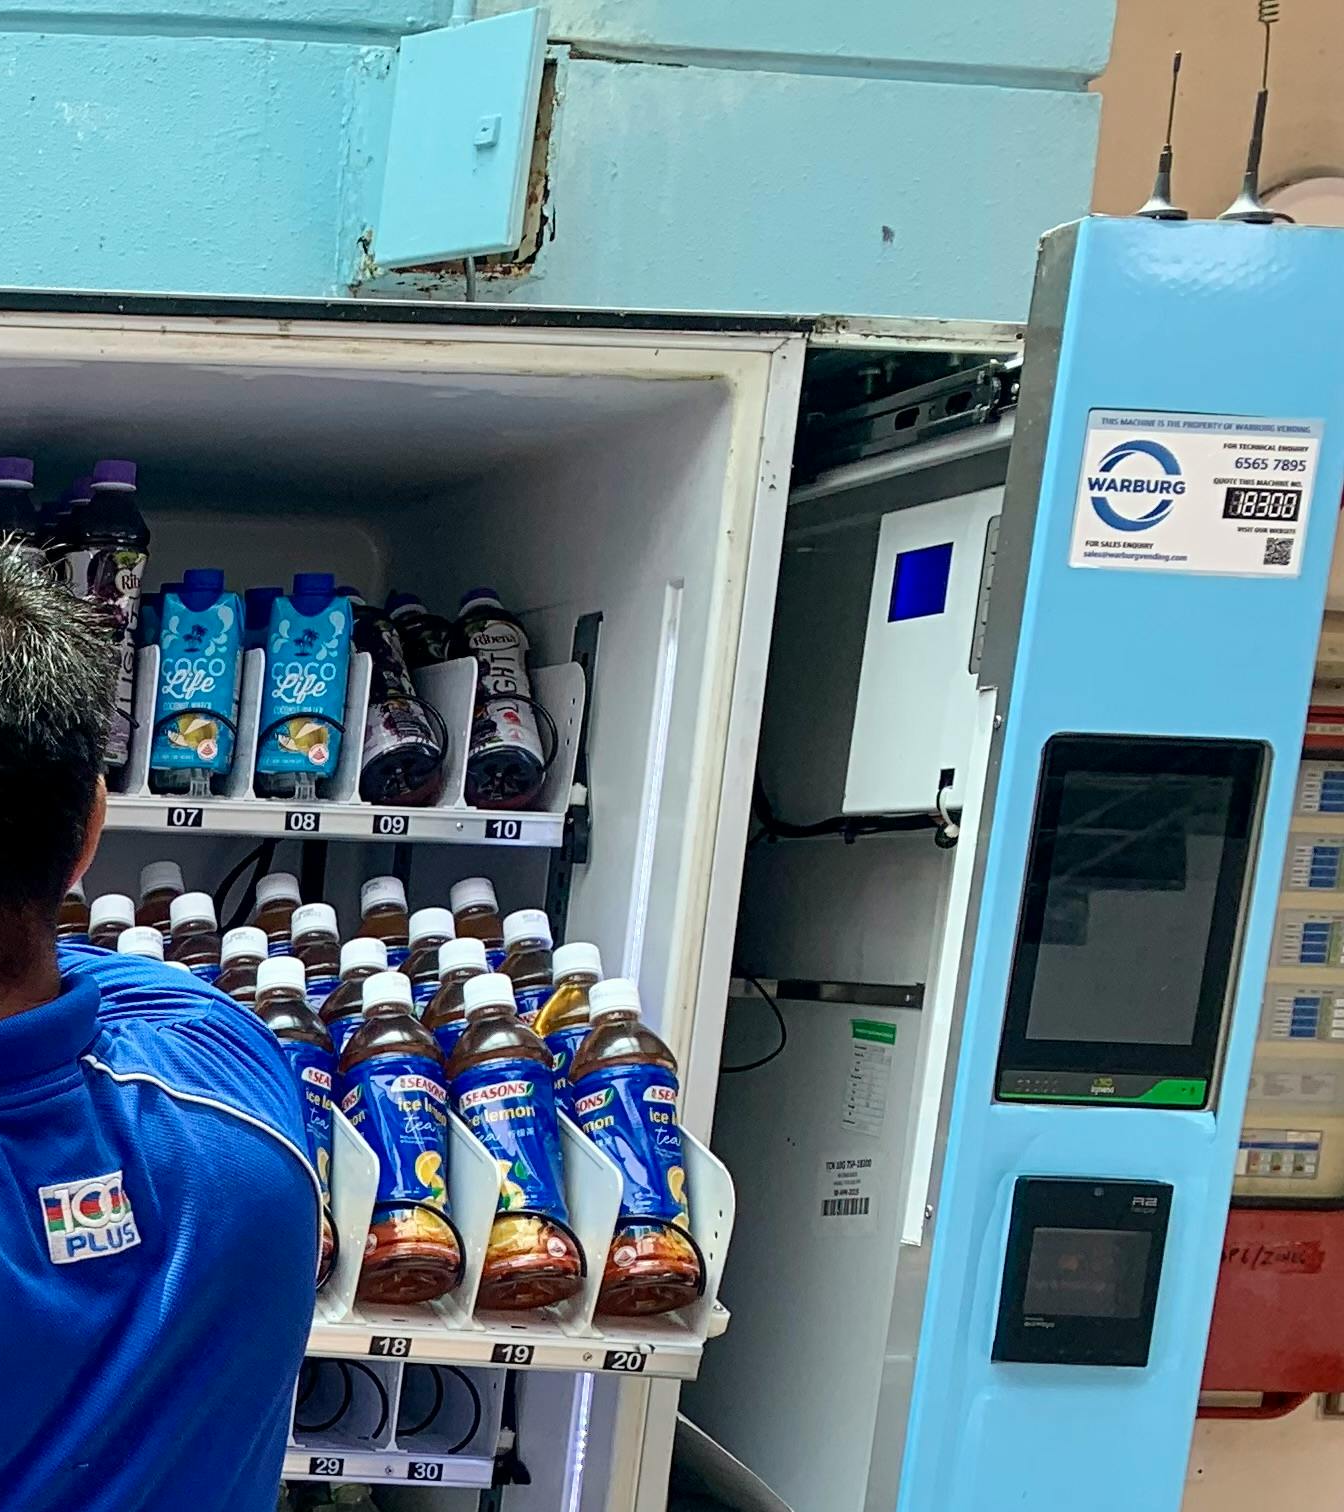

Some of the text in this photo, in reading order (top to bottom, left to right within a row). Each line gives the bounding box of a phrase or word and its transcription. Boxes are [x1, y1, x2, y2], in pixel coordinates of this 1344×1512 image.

[1235, 457, 1306, 472] 6565 7895
[1088, 477, 1186, 494] WARBURG
[472, 633, 516, 647] Ribena
[162, 657, 225, 677] COCO
[272, 662, 336, 681] COCO
[162, 670, 216, 700] Life
[272, 674, 327, 704] Life
[173, 808, 198, 826] 07
[290, 813, 315, 831] 08
[379, 816, 405, 834] 09
[493, 821, 516, 839] 10
[464, 1083, 526, 1106] SEASONS
[485, 1106, 535, 1122] lemon
[54, 1177, 127, 1234] 100
[66, 1222, 135, 1257] PLUS
[378, 1337, 407, 1356] 18
[501, 1345, 530, 1363] 19
[612, 1353, 642, 1370] 20
[315, 1458, 340, 1474] 29
[413, 1463, 439, 1480] 30
